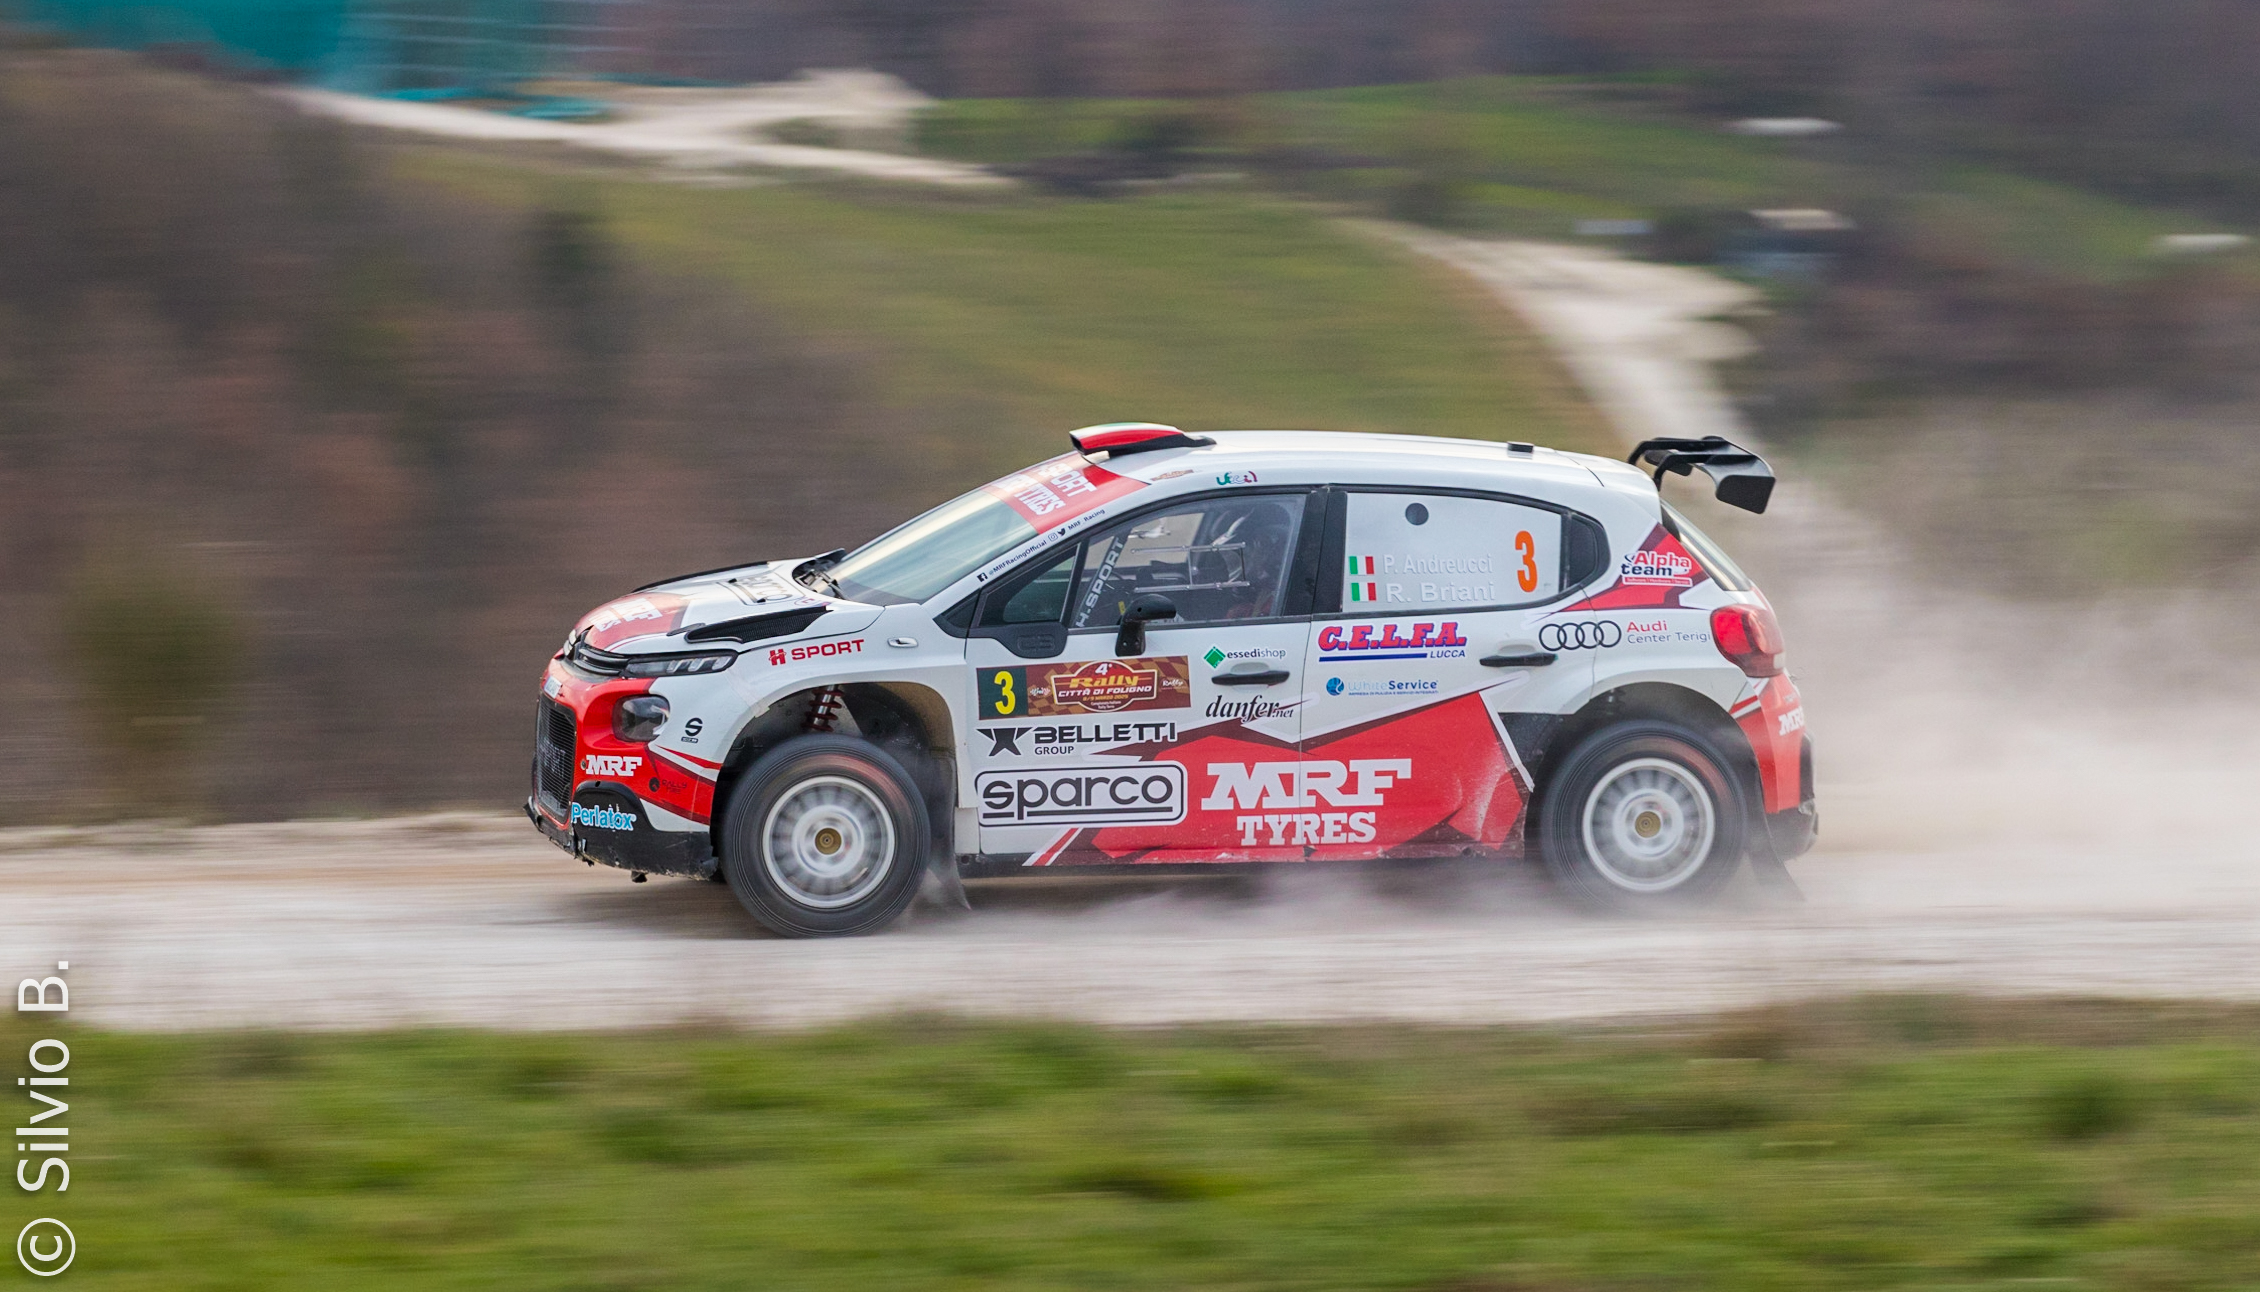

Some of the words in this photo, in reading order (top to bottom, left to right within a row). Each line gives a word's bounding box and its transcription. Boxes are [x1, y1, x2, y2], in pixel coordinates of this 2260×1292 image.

[1383, 554, 1398, 574] P.
[1403, 553, 1494, 574] Andreucci
[1514, 530, 1538, 592] 3
[1621, 563, 1672, 576] team
[1634, 552, 1691, 569] Alpha
[1075, 537, 1124, 628] H-SPORT
[1386, 583, 1411, 603] R.
[1420, 581, 1495, 602] Briani
[1318, 621, 1467, 652] C.E.L.F.A.
[1627, 620, 1667, 632] Audi
[1627, 633, 1671, 644] Center
[1675, 631, 1711, 643] Terigi
[791, 639, 864, 660] SPORT
[1227, 648, 1287, 660] essedishop
[1430, 650, 1466, 659] LUCCA
[994, 670, 1016, 715] 3
[1069, 675, 1139, 689] Rally
[1106, 685, 1152, 694] FOLIGNO
[1033, 722, 1176, 745] BELLETTI
[1034, 746, 1075, 755] GROUP
[586, 754, 642, 777] MRF
[1201, 758, 1412, 811] MRF
[983, 775, 1173, 820] sparco
[572, 801, 634, 831] Perlatox
[1236, 811, 1377, 846] TYRES
